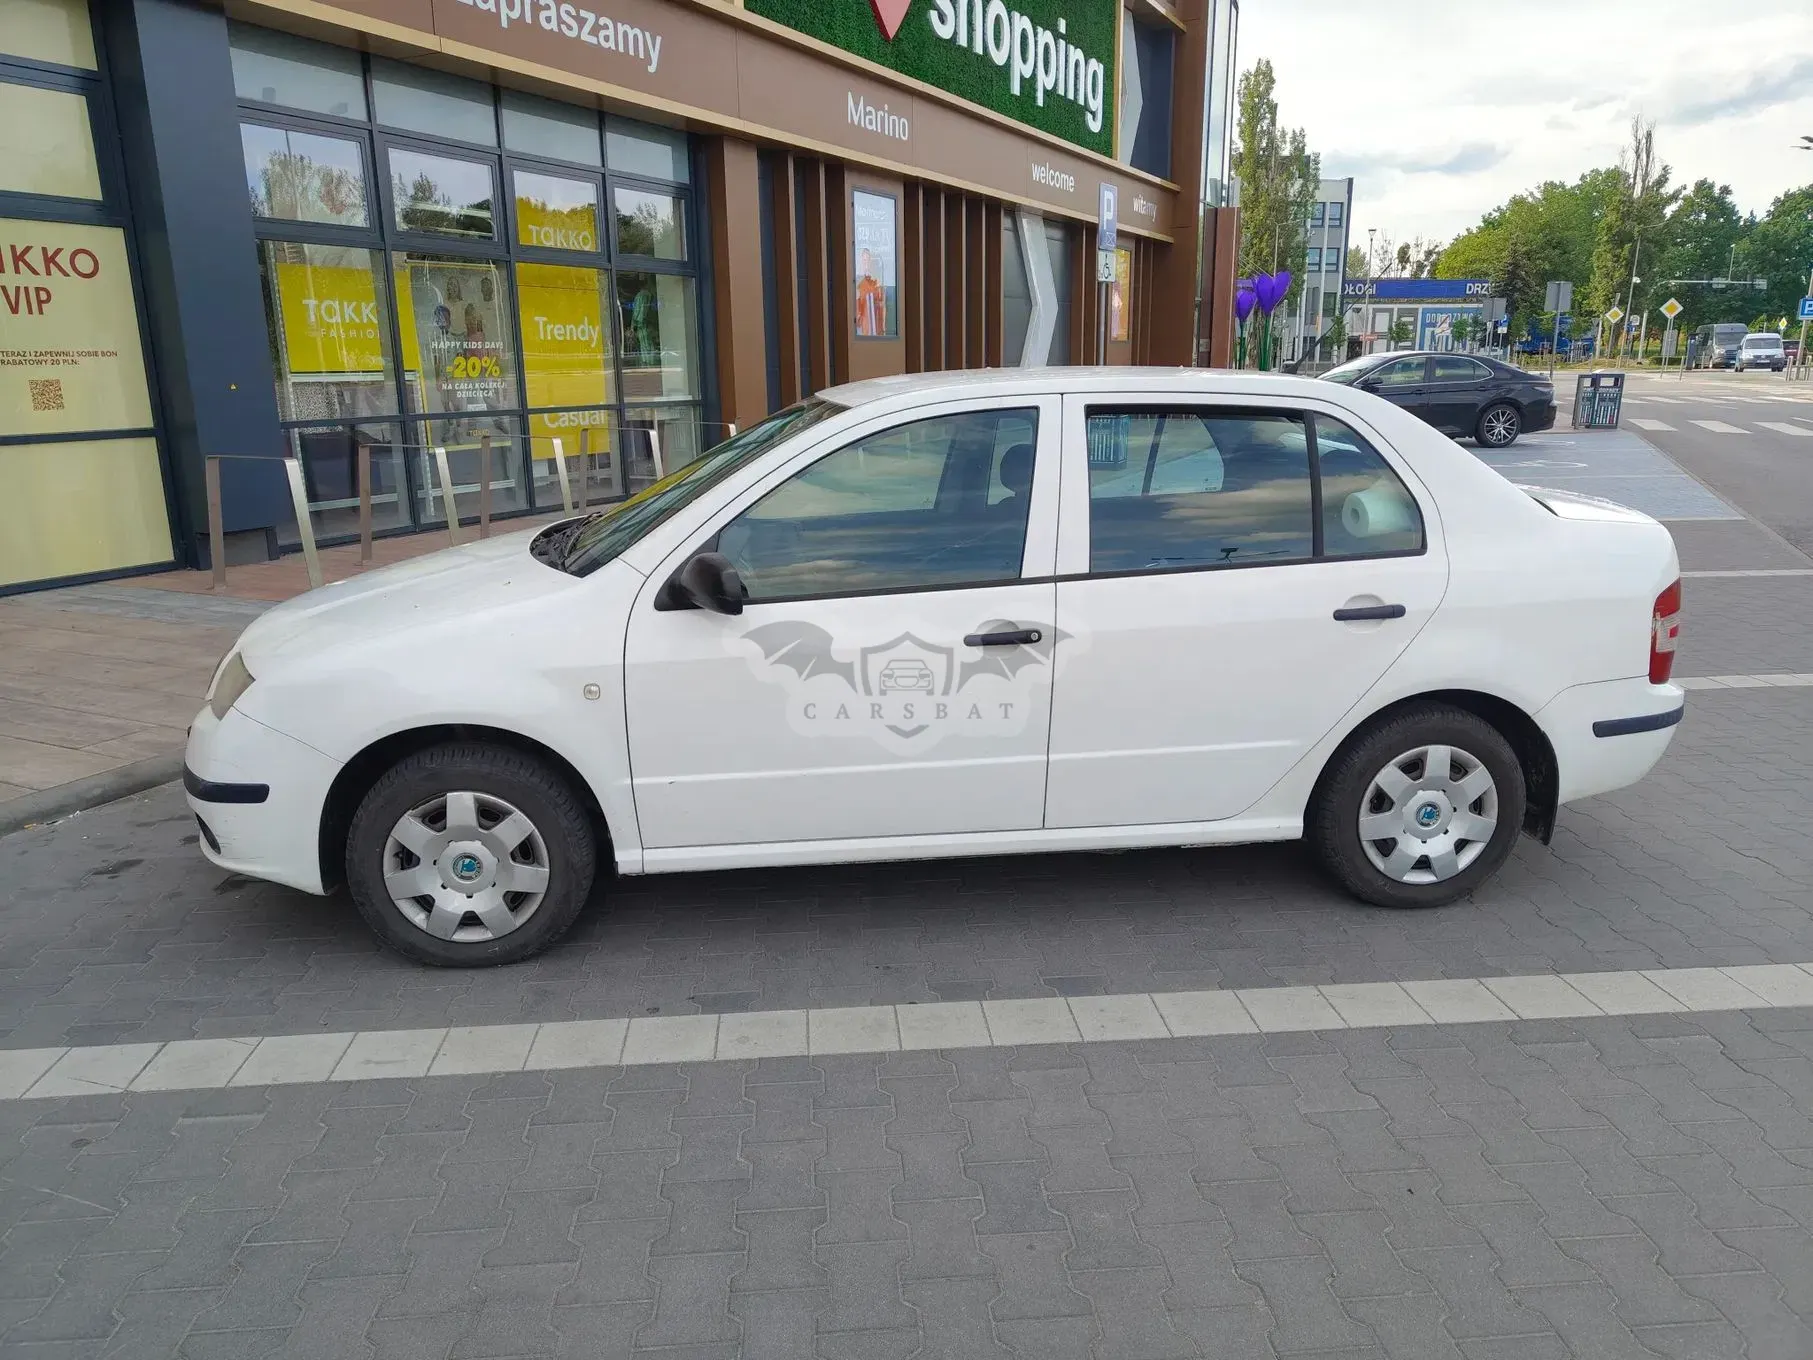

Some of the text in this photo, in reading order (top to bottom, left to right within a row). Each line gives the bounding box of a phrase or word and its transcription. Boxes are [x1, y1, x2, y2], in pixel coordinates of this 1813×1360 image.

[455, 0, 662, 73] praszamy
[847, 90, 908, 140] Marino
[1031, 162, 1075, 192] welcome
[1103, 190, 1114, 230] P
[1132, 194, 1157, 222] witamy
[0, 285, 52, 315] VIP
[320, 328, 380, 339] FASHIO
[431, 341, 461, 349] HAPPY
[463, 341, 483, 349] KIDS
[534, 316, 600, 347] Trendy
[34, 350, 75, 358] ZAPEWNIJ
[442, 383, 453, 391] NA
[475, 381, 507, 389] KOLEKCJ
[543, 405, 606, 429] Casual
